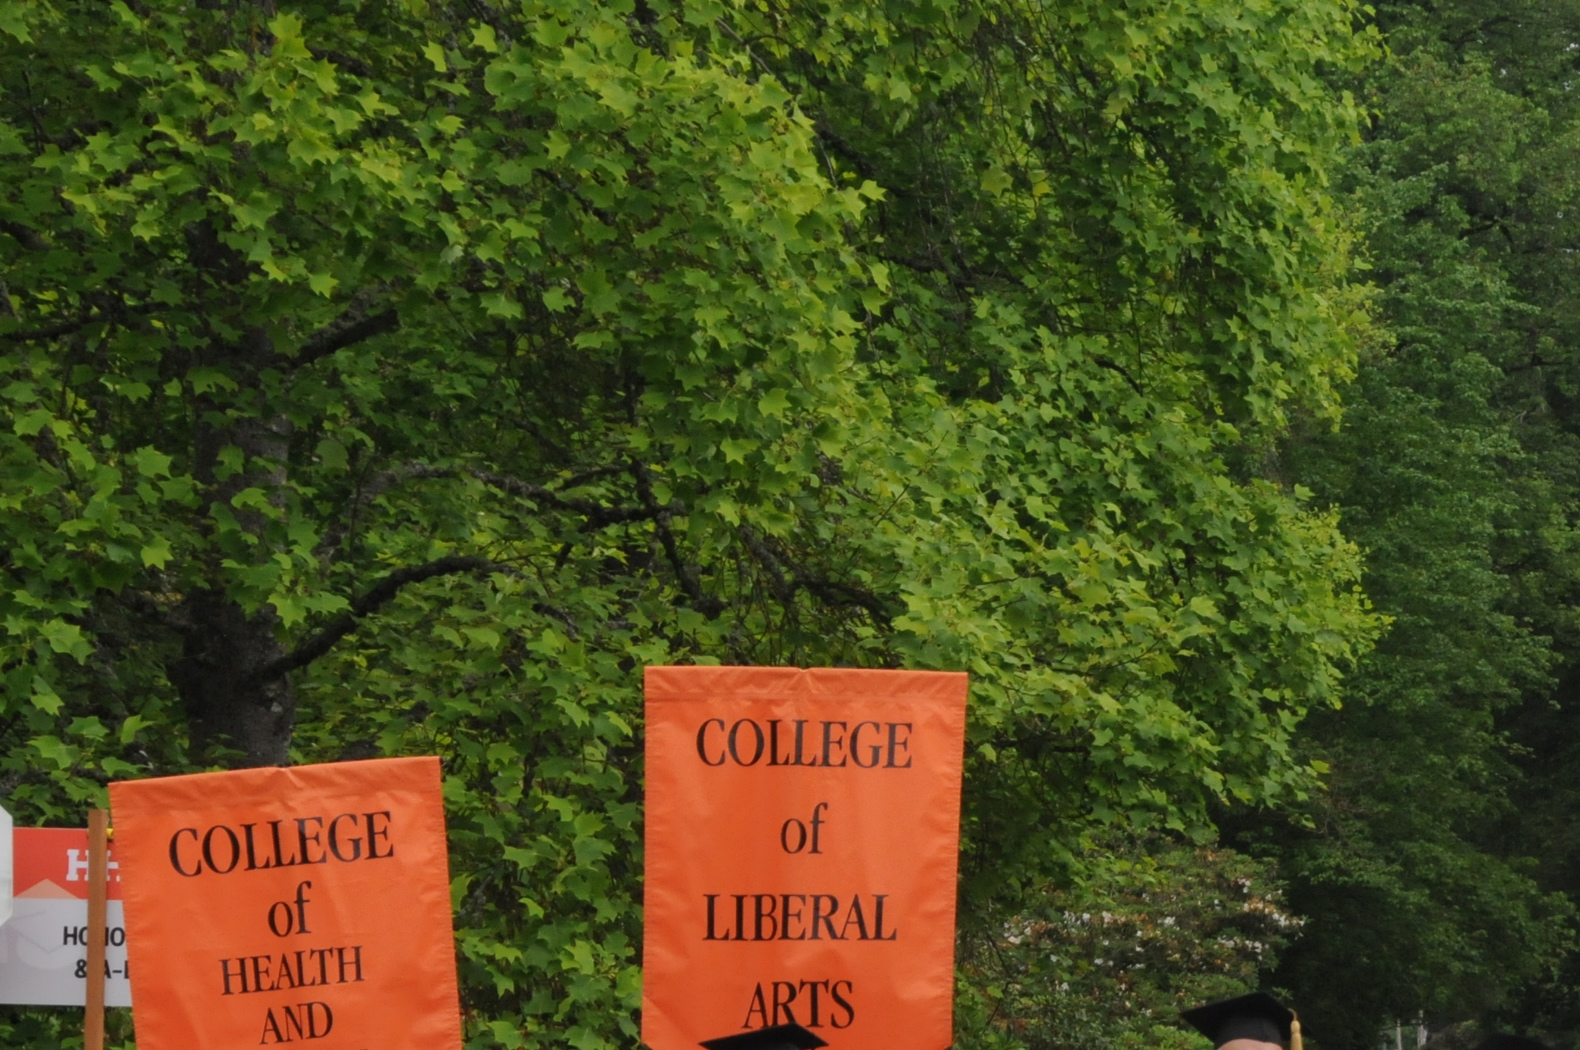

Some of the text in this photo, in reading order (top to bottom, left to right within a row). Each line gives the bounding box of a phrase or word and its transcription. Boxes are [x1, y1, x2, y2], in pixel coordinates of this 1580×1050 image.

[696, 718, 913, 769] COLLEGE
[168, 810, 395, 878] COLLEGE
[780, 802, 829, 855] of
[267, 881, 313, 938] of
[703, 893, 897, 942] LIBERAL
[220, 945, 364, 996] HEALTH
[259, 1001, 334, 1046] AND
[742, 979, 855, 1029] ARTS
